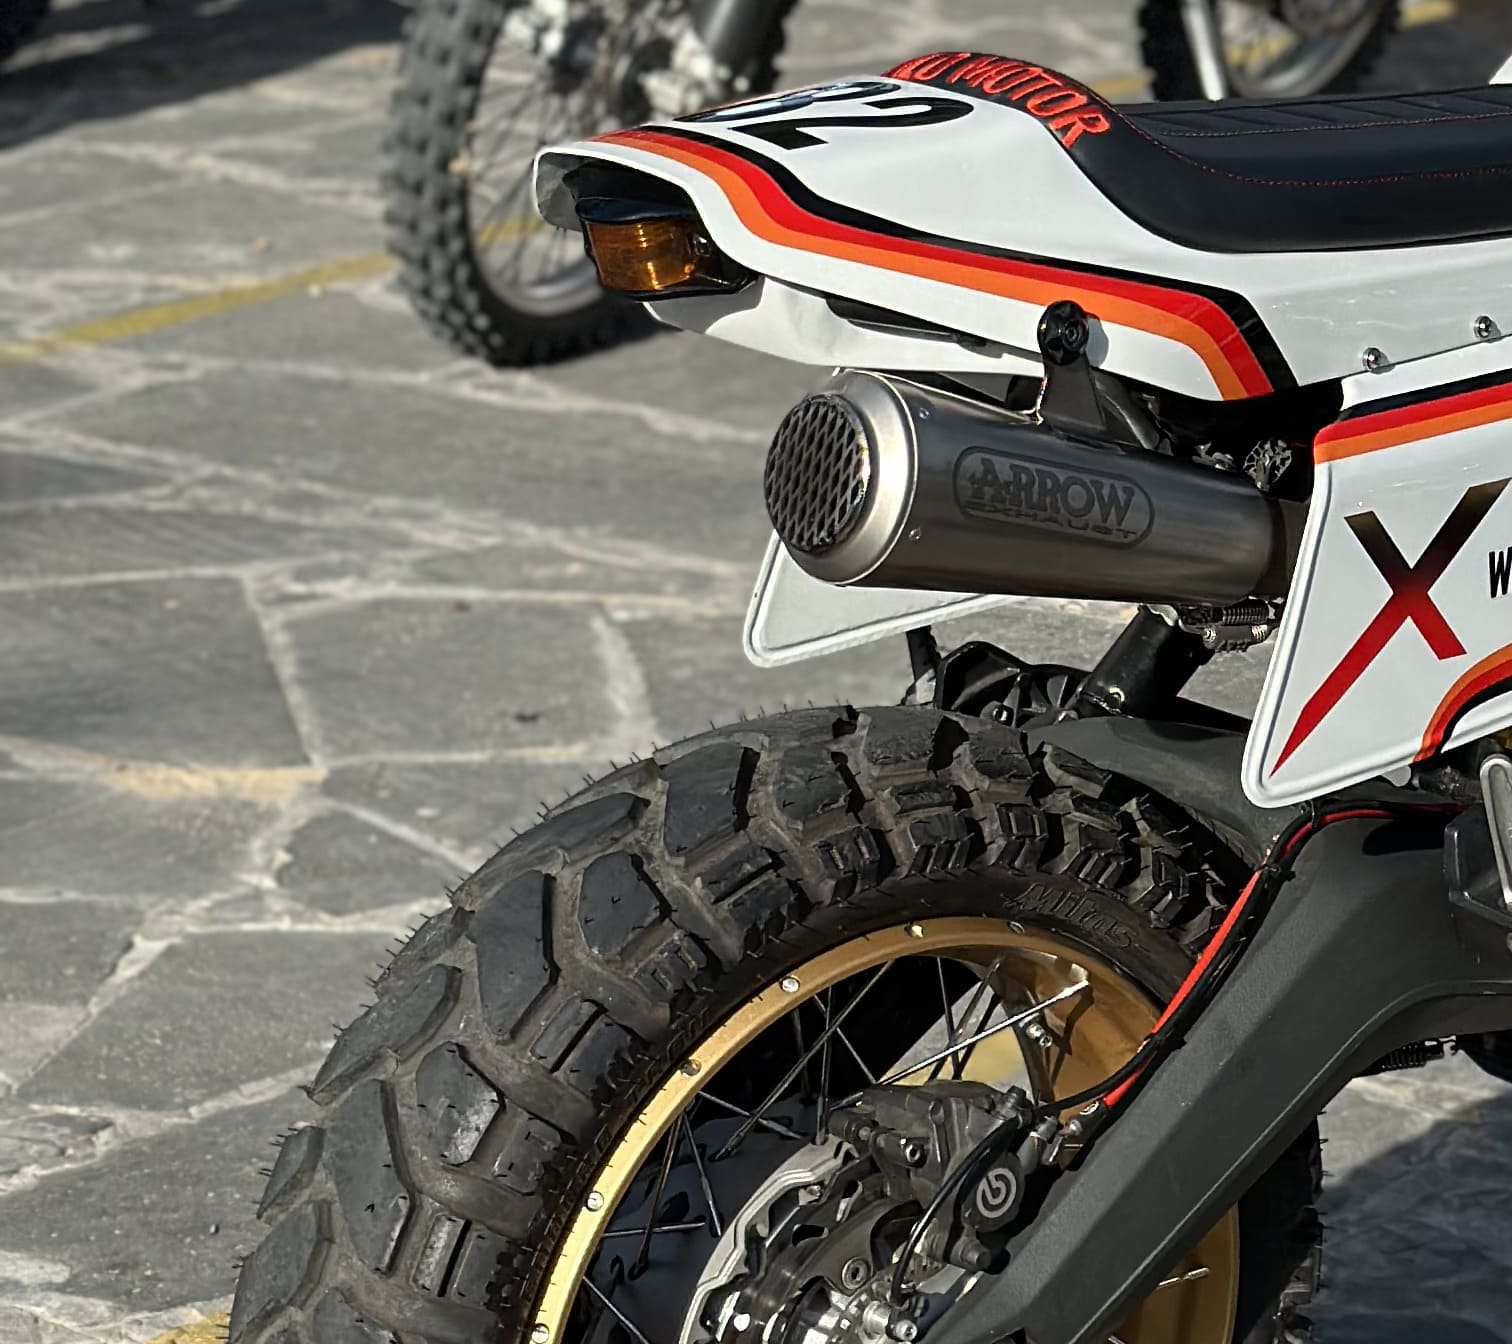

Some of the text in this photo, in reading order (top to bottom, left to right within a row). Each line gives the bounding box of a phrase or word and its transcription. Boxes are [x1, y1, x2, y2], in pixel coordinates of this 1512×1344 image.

[945, 56, 1111, 149] MOTOR
[966, 457, 1137, 528] ARROW
[1268, 476, 1512, 780] X
